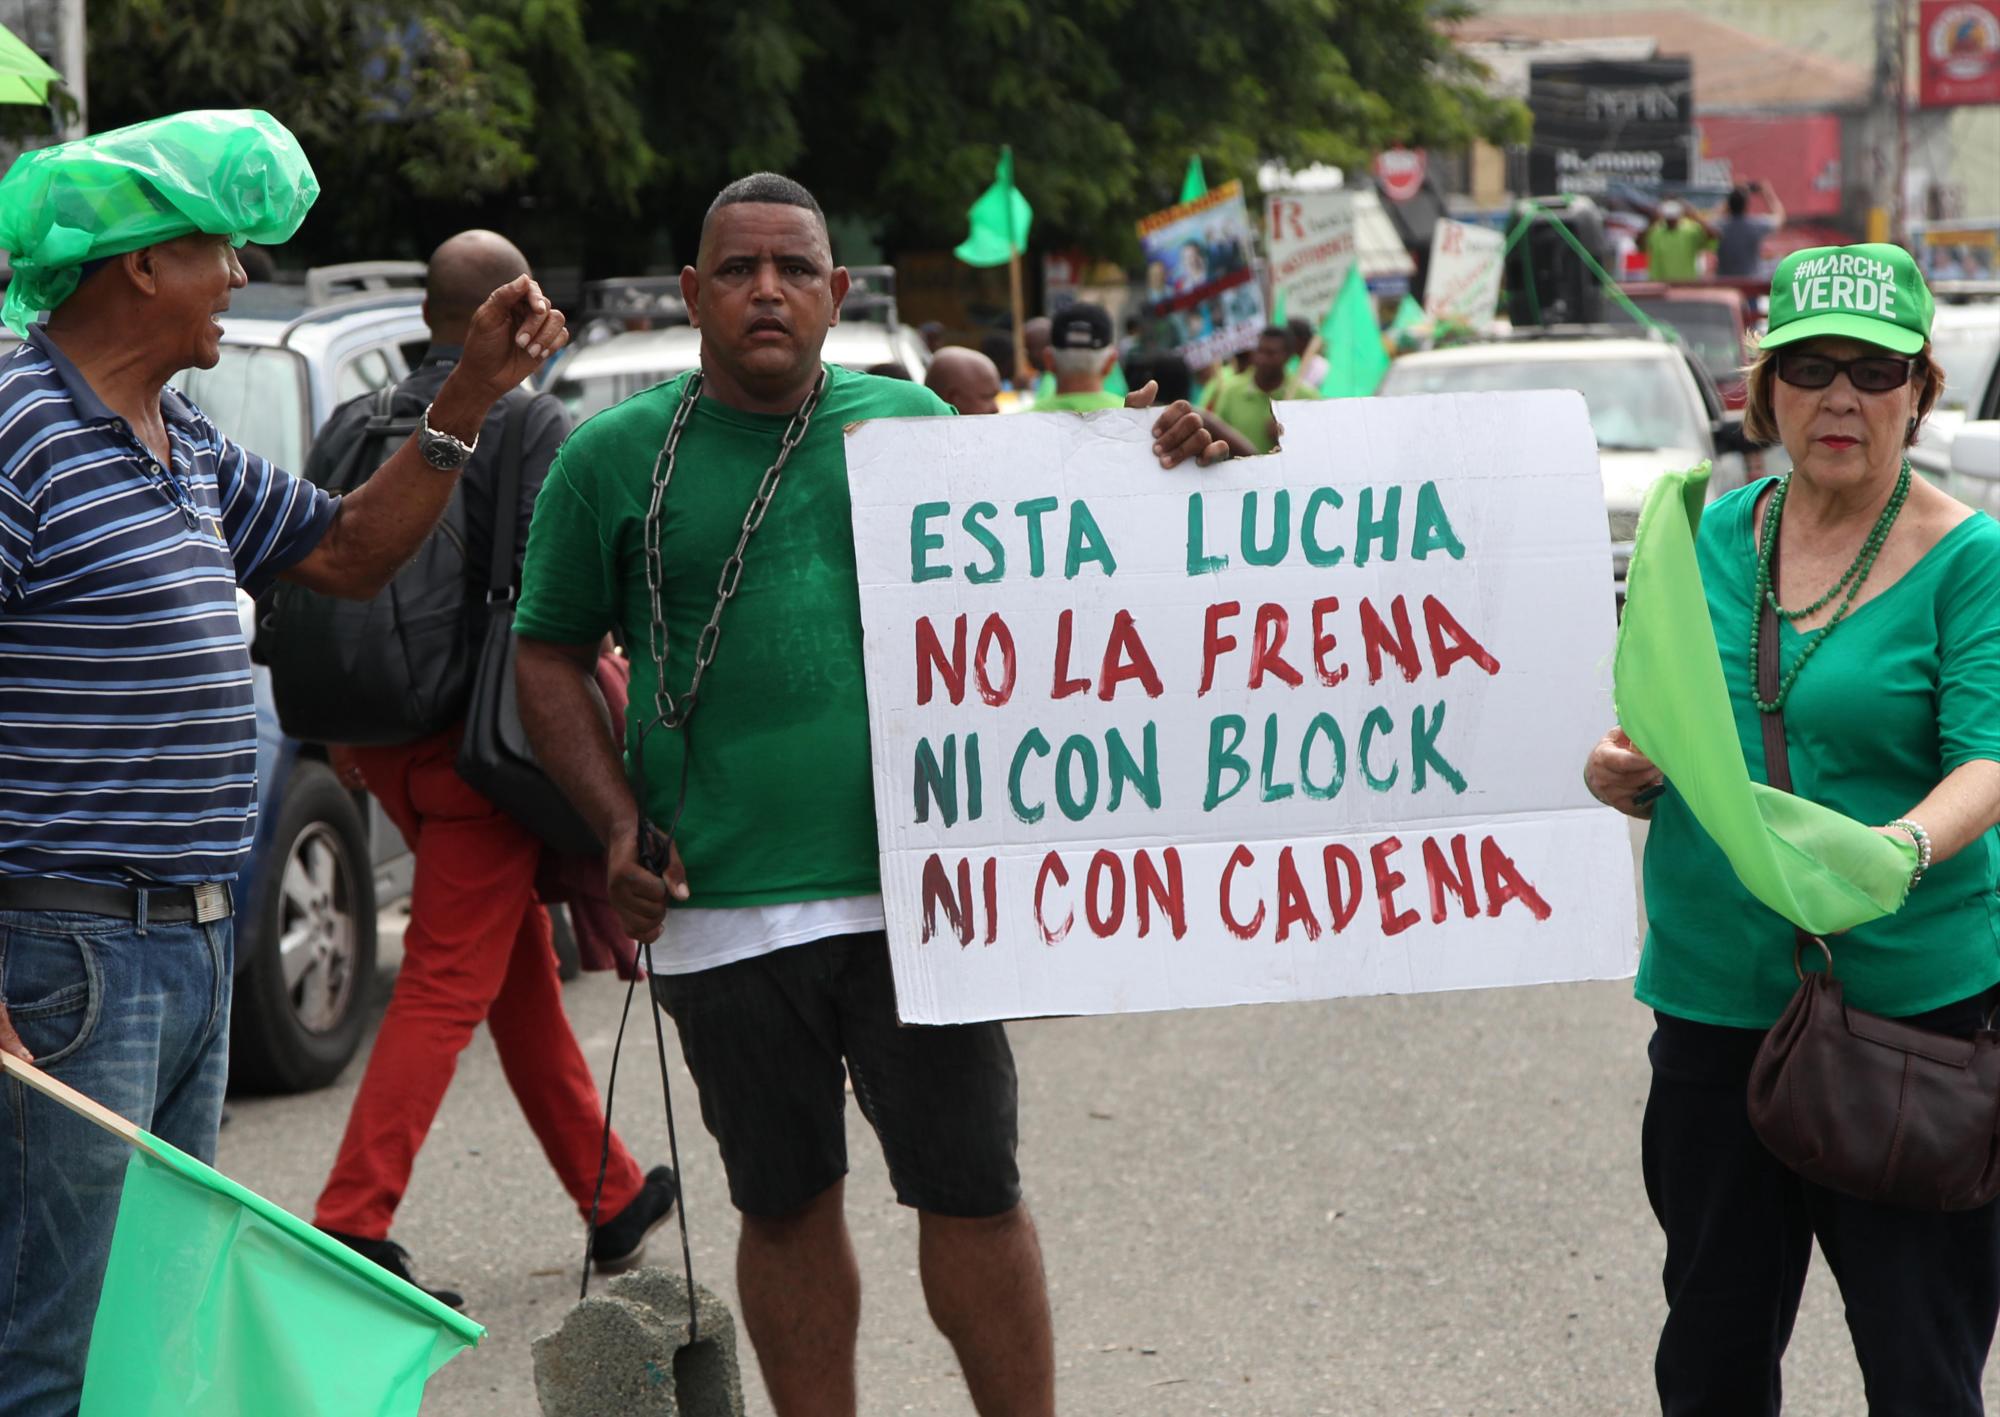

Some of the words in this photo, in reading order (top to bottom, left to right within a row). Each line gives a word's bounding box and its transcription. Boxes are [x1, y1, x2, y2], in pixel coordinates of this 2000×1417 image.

[1792, 275, 1897, 319] VERDE
[1793, 254, 1895, 286] #MARCHA
[911, 497, 1116, 584] ESTA
[1187, 481, 1466, 577] LUCHA
[916, 613, 1016, 707] NO
[1052, 609, 1164, 702] LA
[1199, 595, 1501, 699] FRENA
[915, 732, 982, 828] NI
[1009, 720, 1162, 824] CON
[1204, 700, 1468, 812] BLOCK
[922, 853, 997, 949] NI
[1033, 847, 1188, 947] CON
[1220, 834, 1552, 945] CADENA
